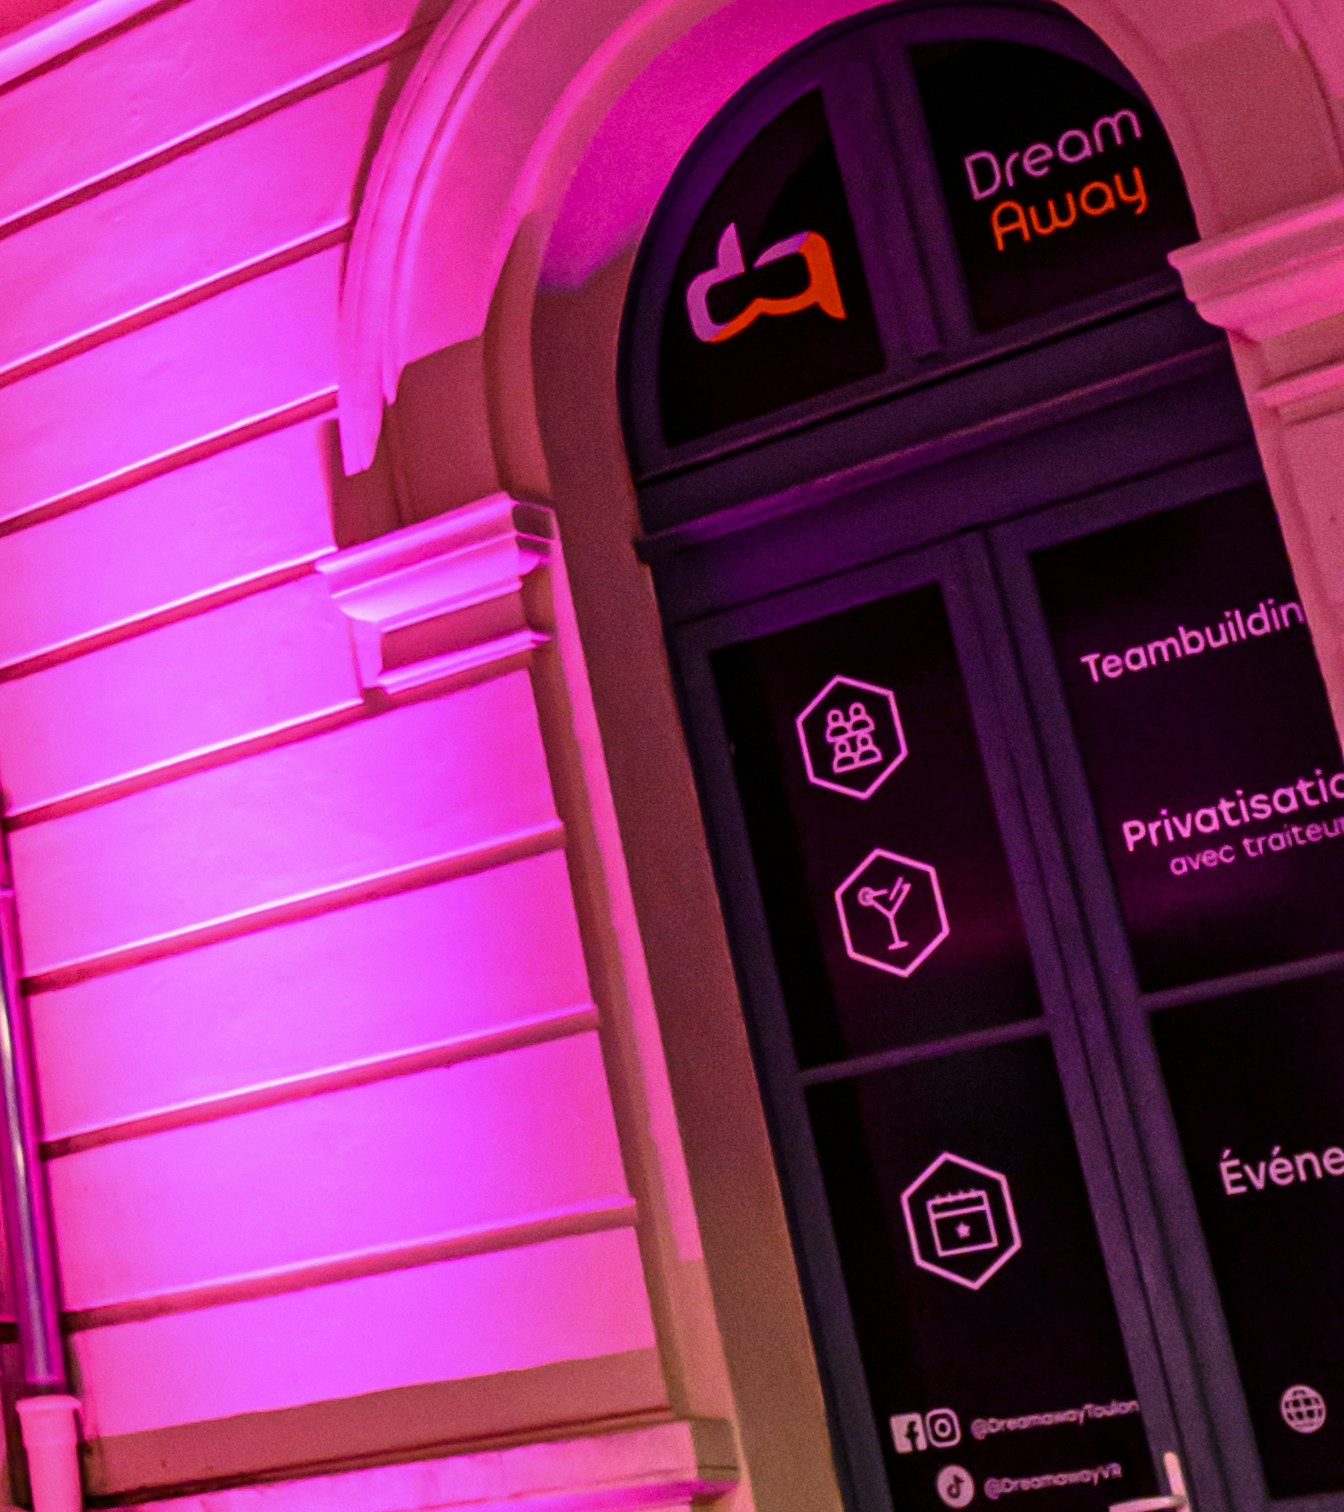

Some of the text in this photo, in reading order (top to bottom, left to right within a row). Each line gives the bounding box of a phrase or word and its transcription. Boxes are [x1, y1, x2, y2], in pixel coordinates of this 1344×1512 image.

[964, 109, 1142, 200] Dream
[991, 166, 1148, 251] Away
[1169, 844, 1236, 877] avec
[1219, 1147, 1344, 1196] Événe
